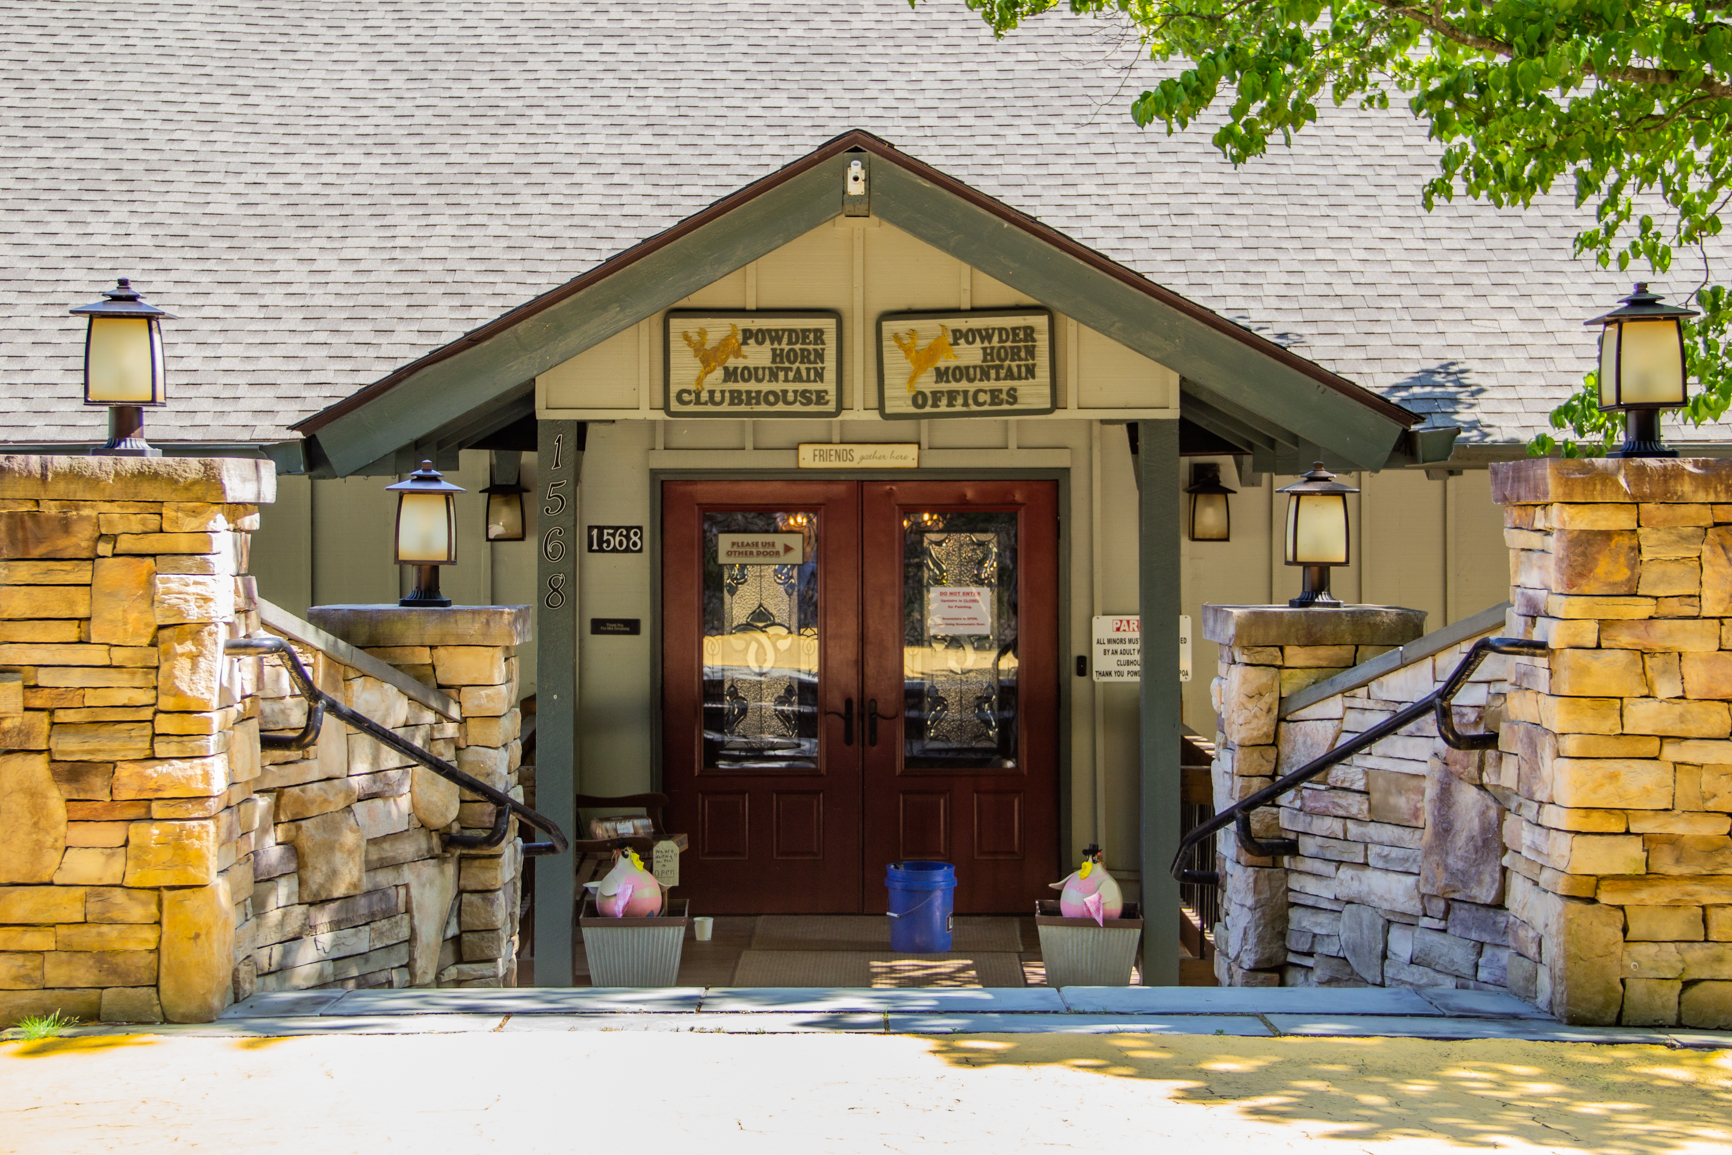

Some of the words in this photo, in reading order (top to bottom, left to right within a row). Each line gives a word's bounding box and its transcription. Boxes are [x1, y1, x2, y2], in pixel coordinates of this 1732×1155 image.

[740, 327, 827, 346] POWDER
[949, 325, 1037, 346] POWDER
[770, 347, 826, 365] HORN
[981, 344, 1037, 364] HORN
[722, 365, 826, 384] MOUNTAIN
[934, 363, 1037, 384] MOUNTAIN
[675, 388, 831, 407] CLUBHOUSE
[911, 387, 1018, 410] OFFICES
[812, 448, 855, 463] FRIENDS
[857, 450, 887, 465] gather
[889, 449, 910, 461] here
[542, 433, 567, 610] 1568
[591, 528, 642, 551] 1568
[731, 540, 760, 548] PLEASE
[760, 540, 776, 548] USE
[1096, 637, 1106, 645] ALL
[1106, 637, 1127, 645] MINORS
[1127, 637, 1140, 645] MUS
[1103, 648, 1110, 656] BY
[1111, 648, 1118, 656] AN
[1119, 648, 1136, 656] ADULT
[1116, 659, 1140, 667] CLUBHOU
[1095, 670, 1113, 678] THANK
[1114, 670, 1124, 678] YOU
[1126, 670, 1140, 678] POWD
